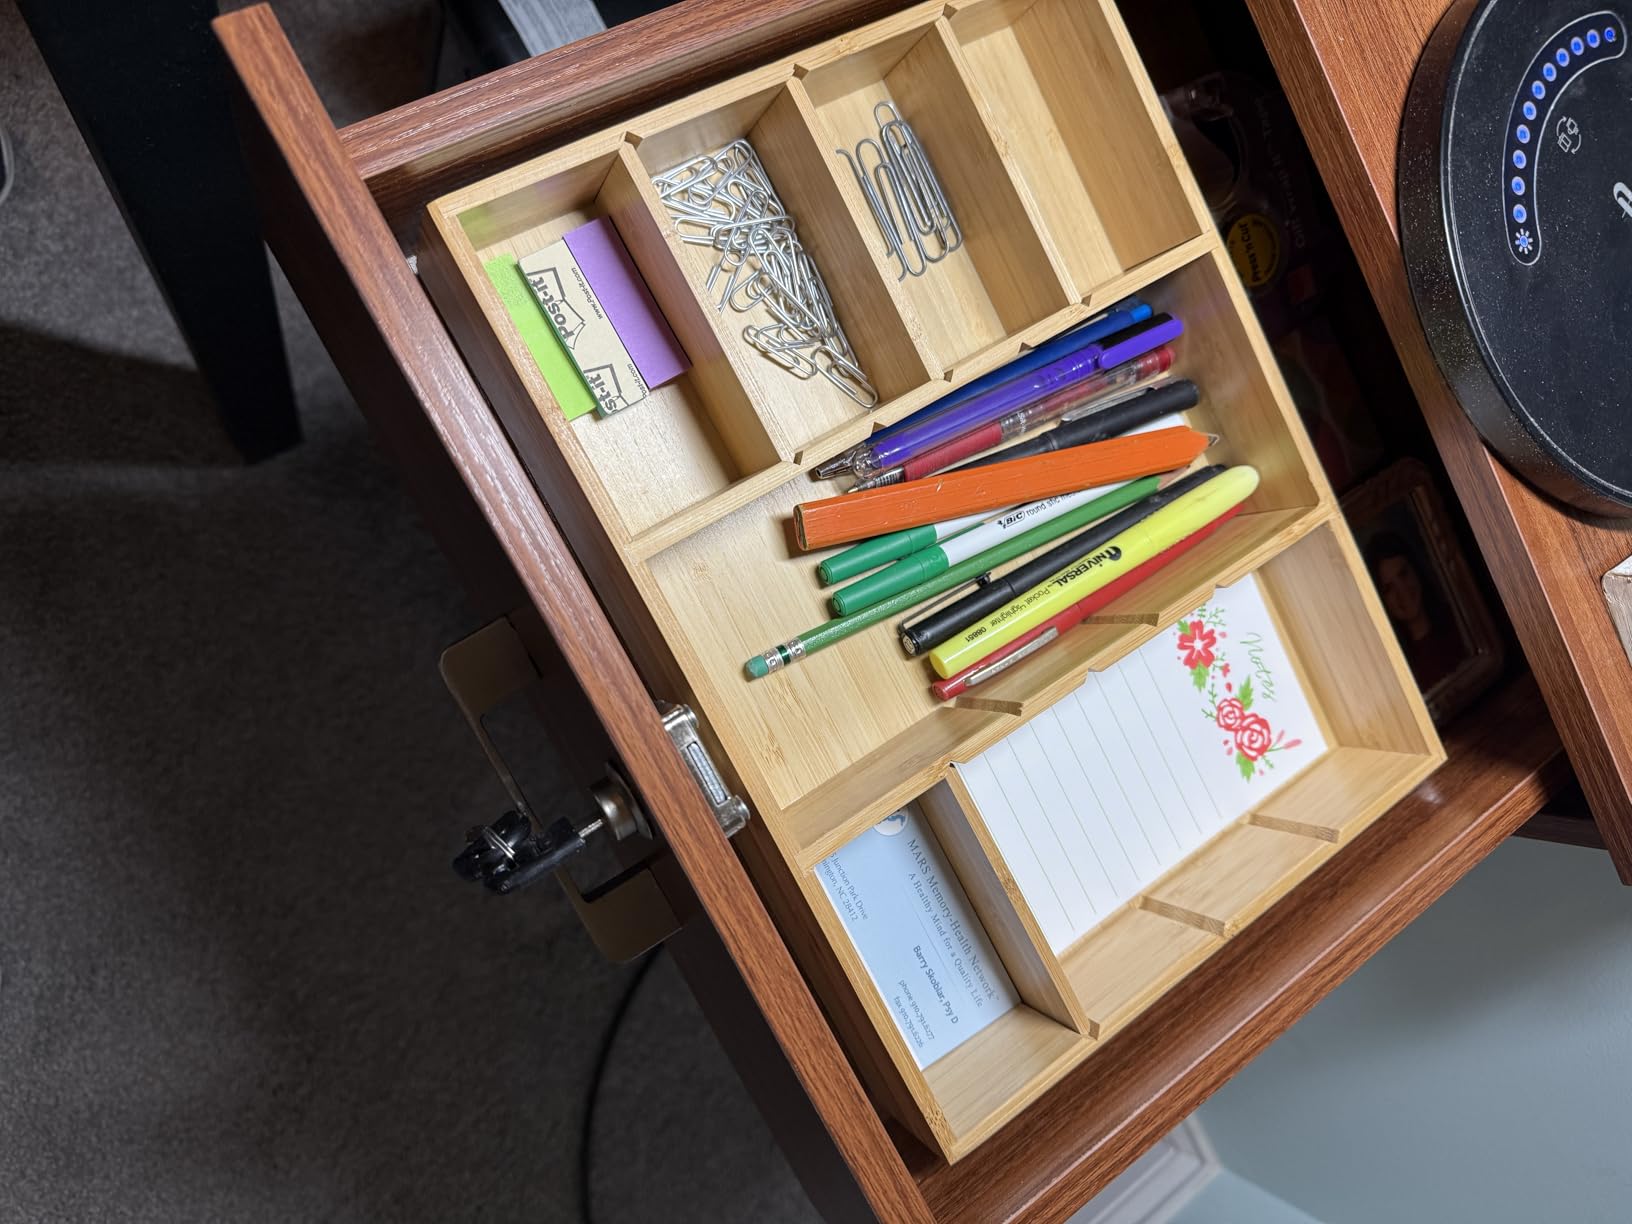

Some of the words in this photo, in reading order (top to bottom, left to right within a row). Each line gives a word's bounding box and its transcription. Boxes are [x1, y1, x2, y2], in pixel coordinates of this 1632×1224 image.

[532, 276, 575, 340] Post-it
[571, 267, 603, 320] www.Post-it.com
[1026, 504, 1047, 519] round
[1023, 587, 1051, 608] Pocket
[830, 859, 850, 889] Junction
[848, 884, 858, 900] Park
[854, 899, 868, 920] Drive
[837, 886, 848, 900] NC
[907, 838, 931, 874] MARS
[927, 874, 971, 956] Memory-Health
[914, 879, 932, 914] Healthy
[931, 911, 945, 937] Mind
[943, 936, 952, 951] for
[953, 957, 974, 991] Quality
[898, 979, 912, 1003] phone
[913, 945, 928, 969] Barry
[942, 1000, 955, 1018] Psy
[950, 1016, 958, 1025] D
